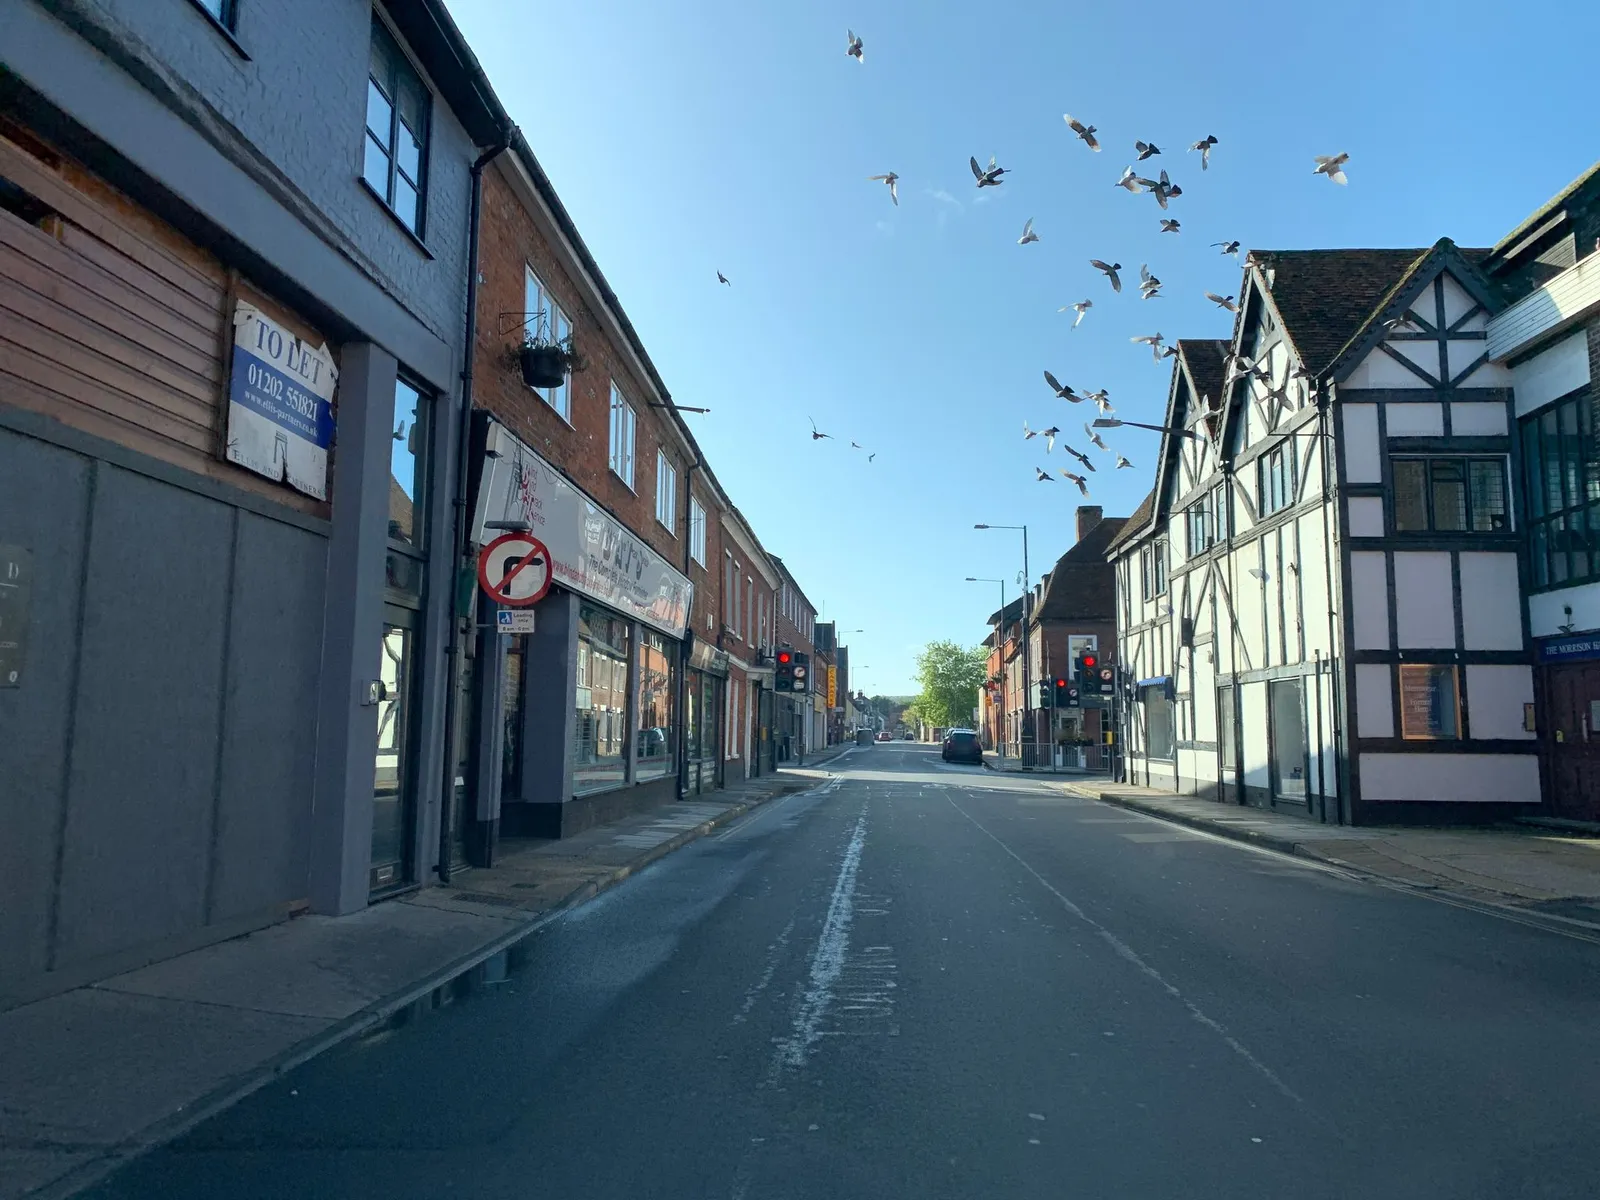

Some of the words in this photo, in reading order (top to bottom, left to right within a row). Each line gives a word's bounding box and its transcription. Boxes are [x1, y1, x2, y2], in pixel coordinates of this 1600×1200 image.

[256, 319, 282, 359] TO
[286, 341, 324, 384] LET
[244, 390, 318, 437] www.ellis-partners.co.uk
[248, 363, 283, 400] 01202
[286, 387, 317, 421] 551821
[1545, 645, 1558, 655] THE
[1559, 642, 1591, 654] MORRISON
